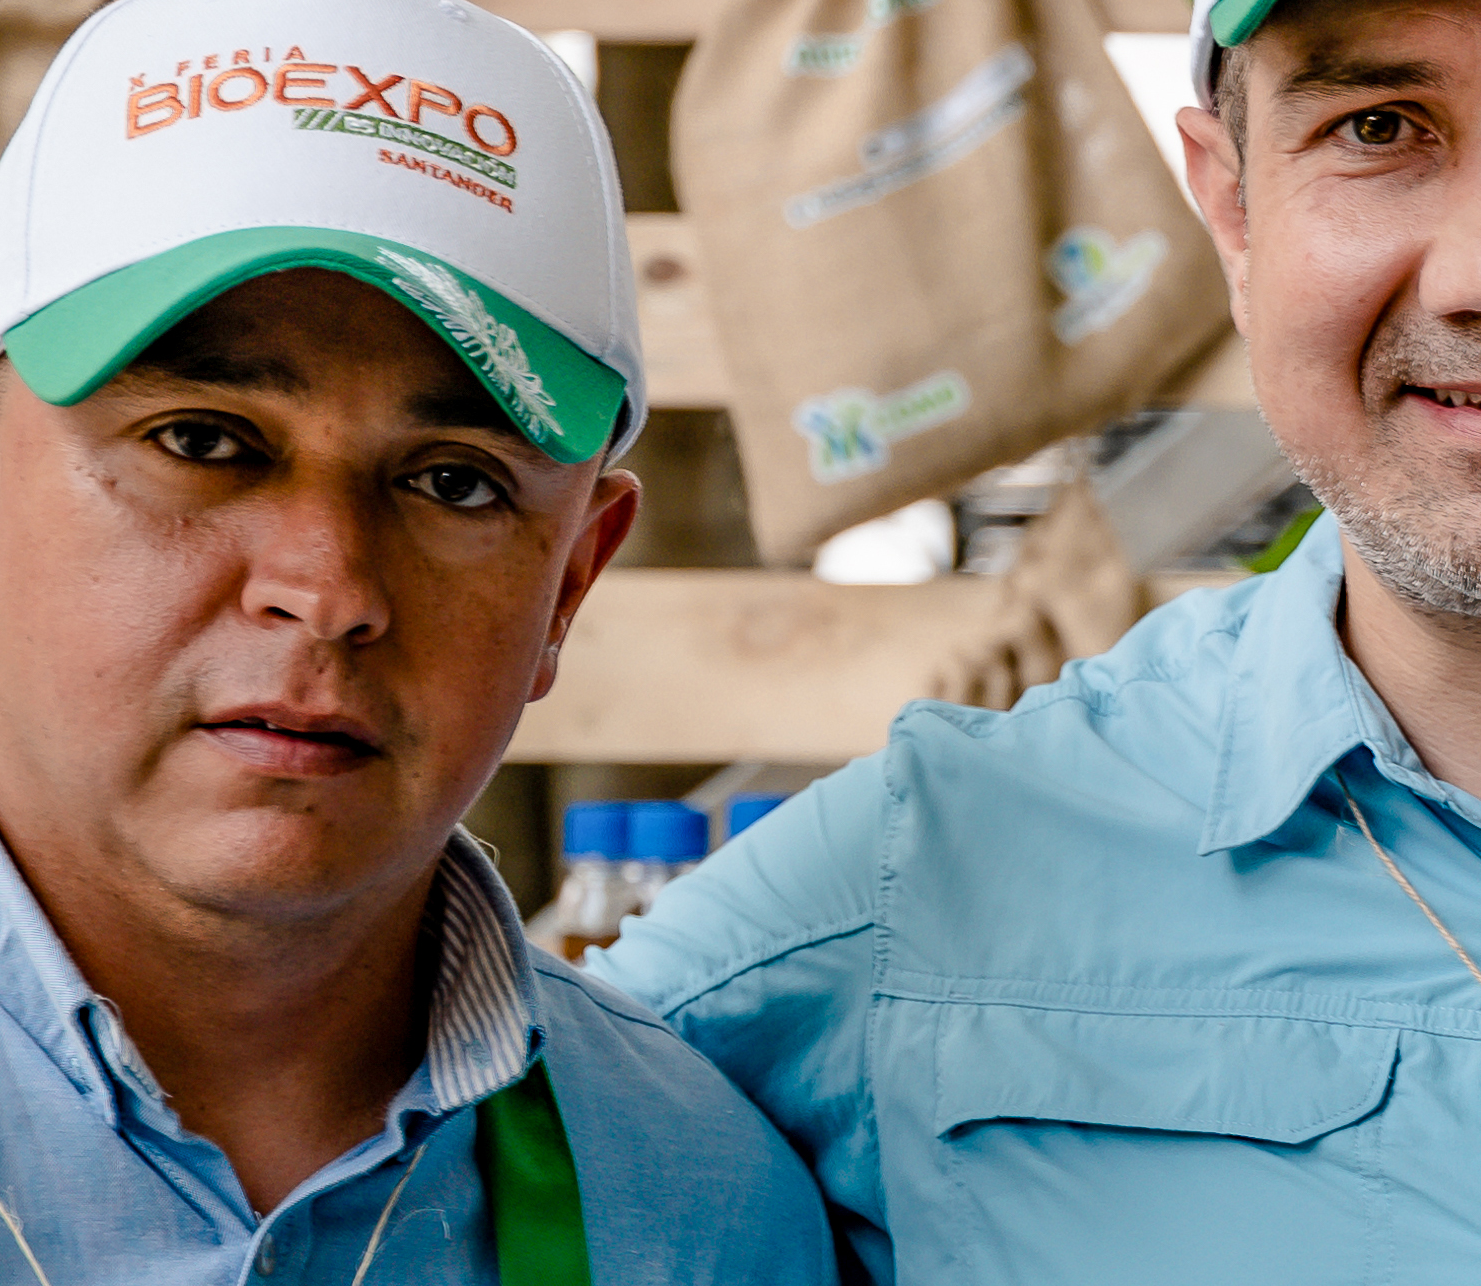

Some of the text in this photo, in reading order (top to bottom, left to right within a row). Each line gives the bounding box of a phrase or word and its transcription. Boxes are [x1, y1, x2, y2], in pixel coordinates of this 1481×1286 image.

[129, 44, 306, 89] X FERIA
[126, 62, 517, 140] BIOEXPO
[343, 116, 376, 134] ES
[377, 148, 513, 213] SANTANDER
